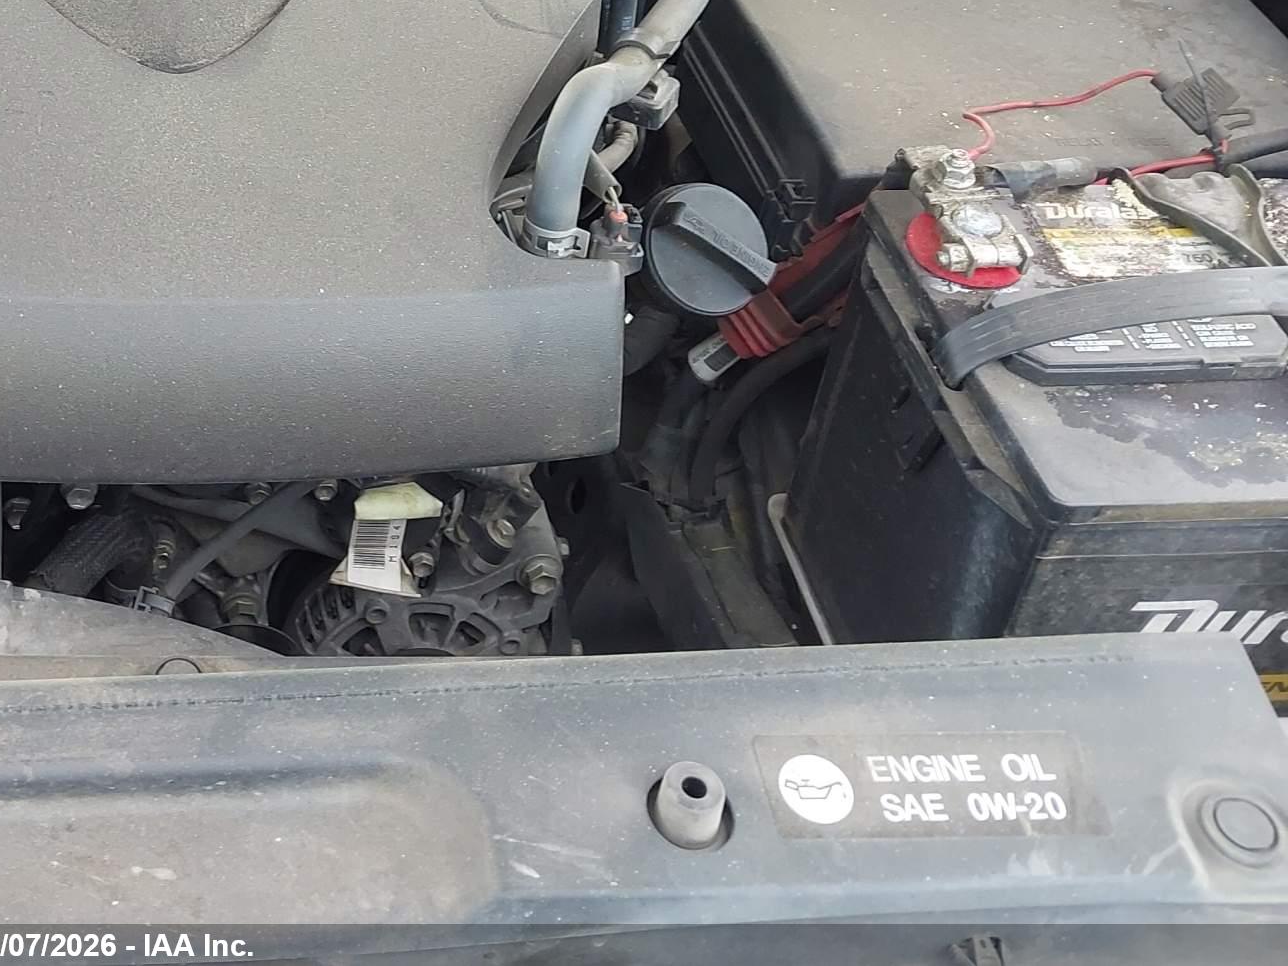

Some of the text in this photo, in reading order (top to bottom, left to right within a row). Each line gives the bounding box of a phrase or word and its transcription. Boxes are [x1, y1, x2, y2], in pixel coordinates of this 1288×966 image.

[1130, 599, 1288, 645] Dur
[866, 753, 1058, 783] ENGINE OIL
[879, 791, 1067, 822] SAE 0W-20
